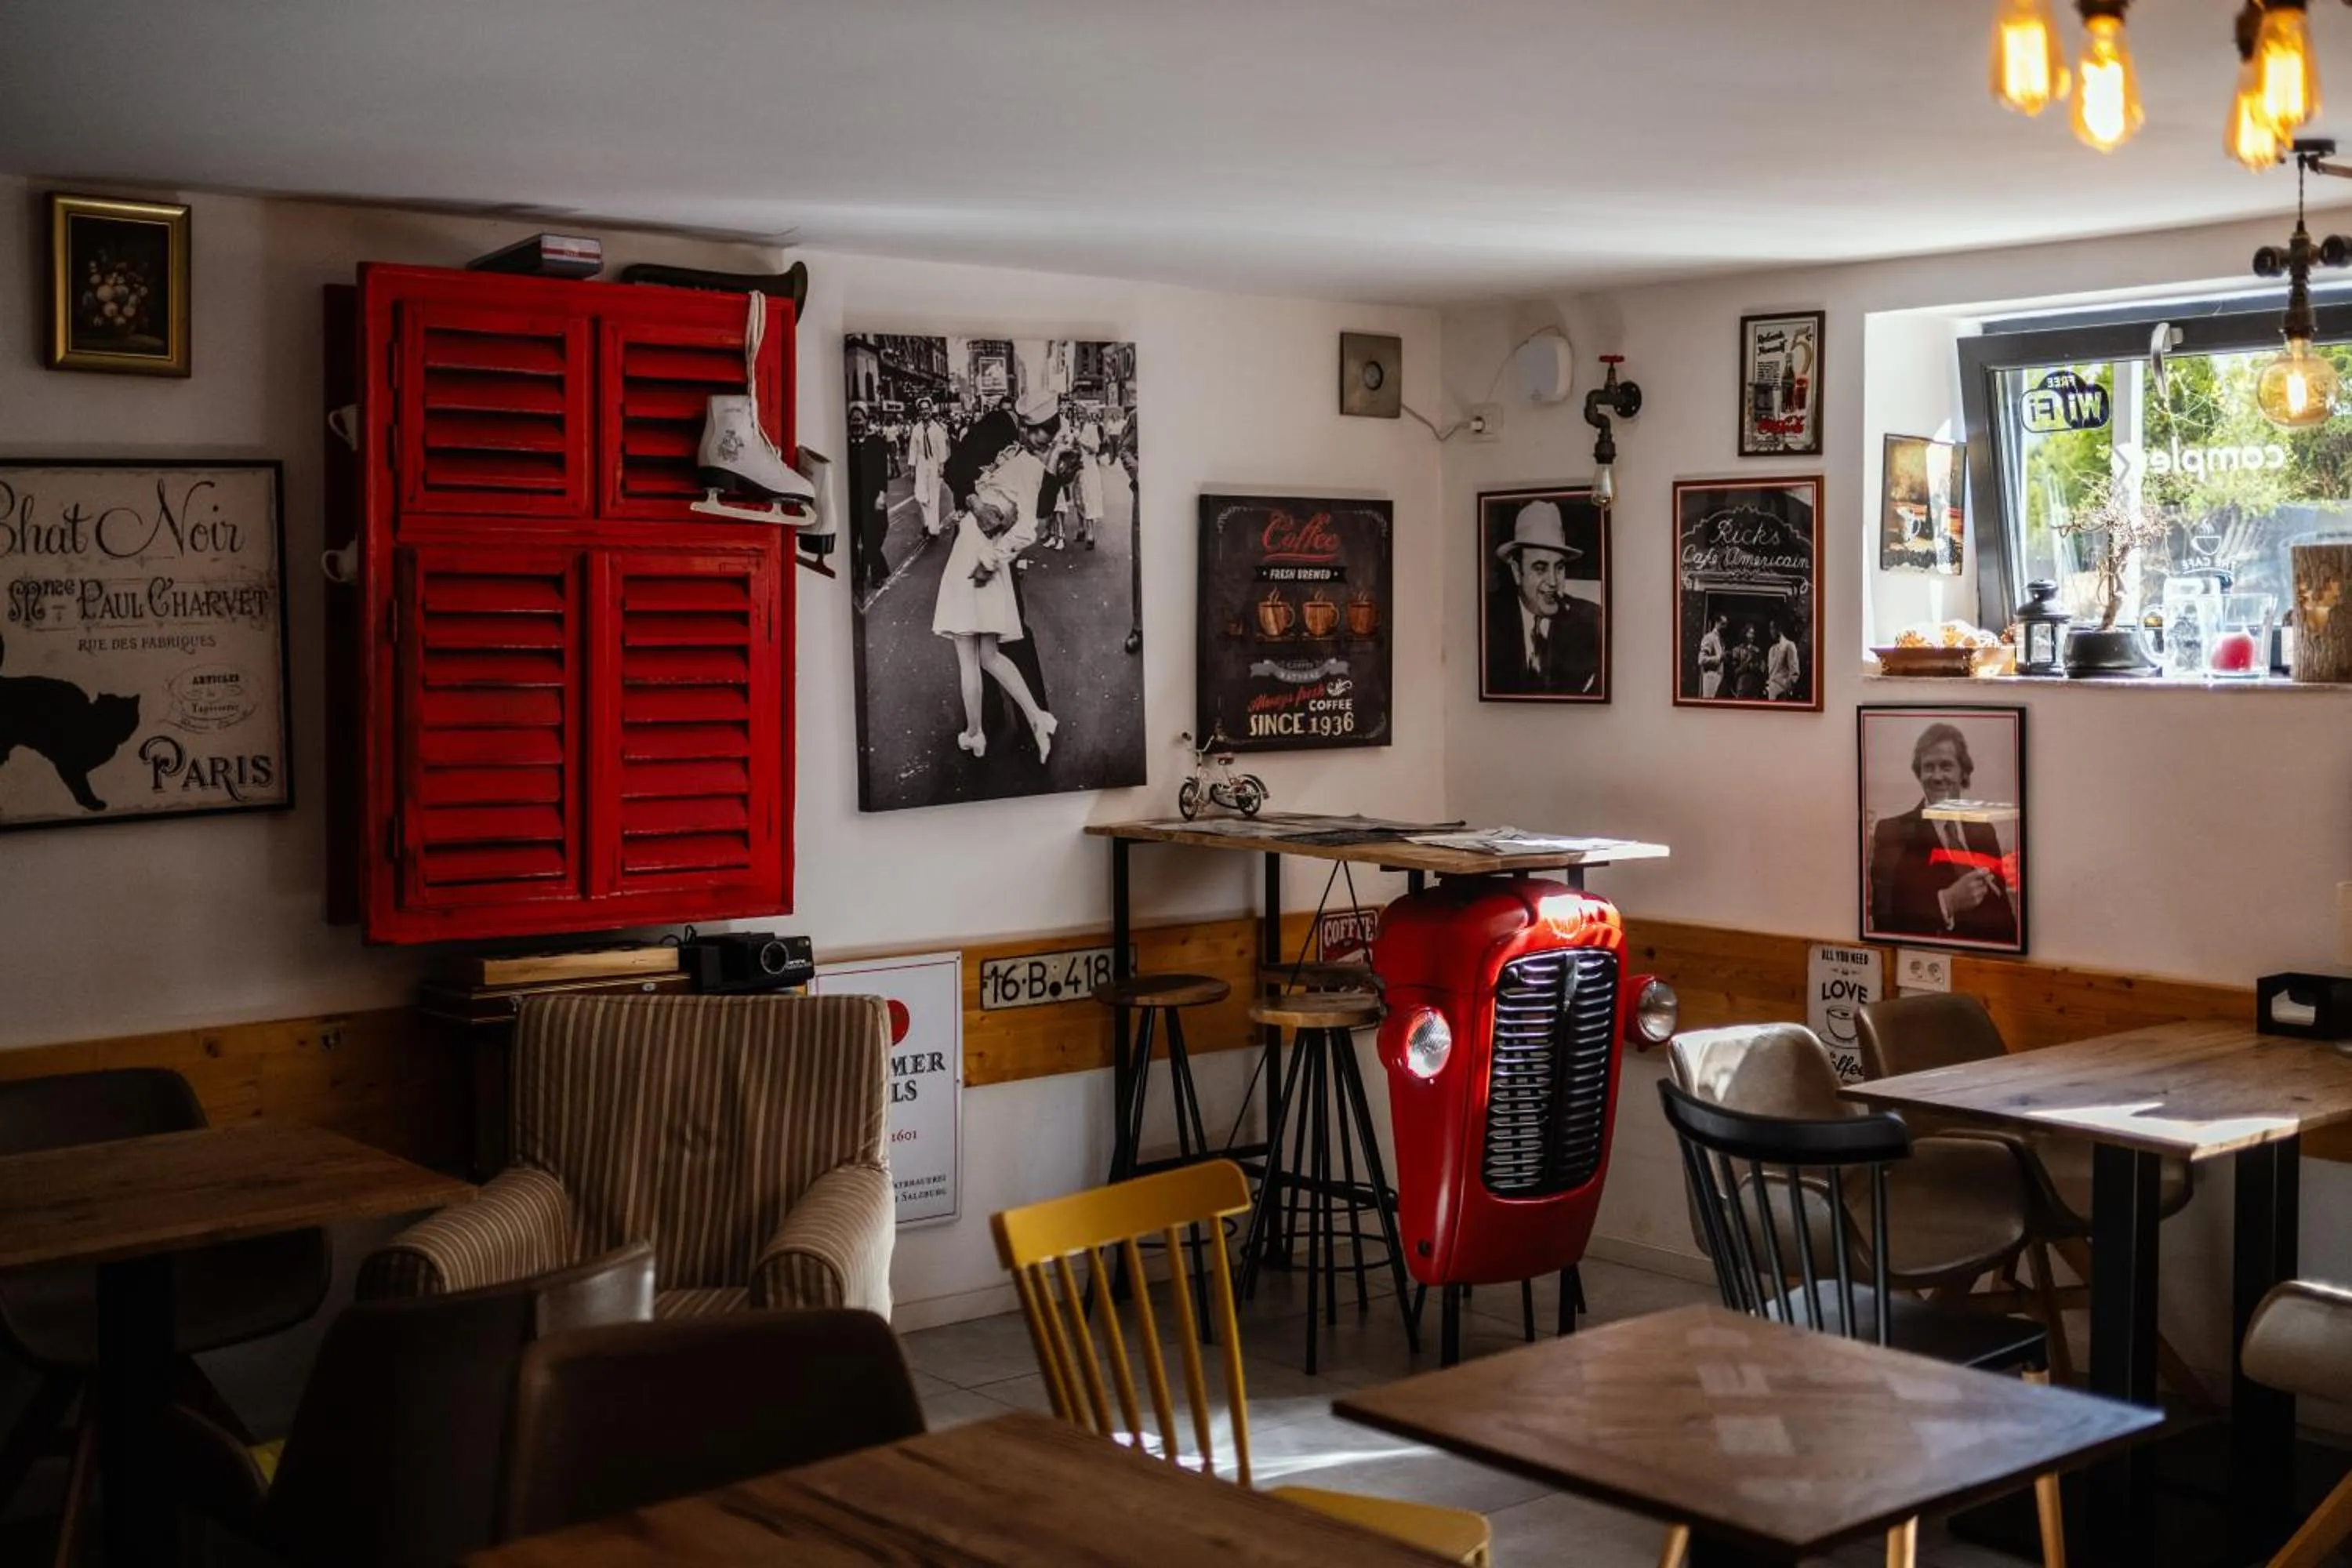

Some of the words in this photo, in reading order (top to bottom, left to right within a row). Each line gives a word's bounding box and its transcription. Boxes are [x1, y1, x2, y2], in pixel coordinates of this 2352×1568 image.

[95, 478, 245, 557] Noir
[1709, 517, 1781, 546] Rick's
[1269, 568, 1296, 580] FRESH
[1298, 568, 1332, 580] BREWED
[78, 579, 145, 621] PAUL
[148, 576, 269, 618] CHARVET
[77, 638, 107, 654] RUE
[112, 637, 138, 650] DES
[141, 635, 216, 655] FABRIQUES
[1308, 699, 1353, 712] COFFEE
[1249, 713, 1305, 737] SINCE
[1308, 712, 1355, 737] 1936
[139, 735, 273, 802] PARIS
[1821, 949, 1835, 961] ALL
[1835, 949, 1849, 963] YOU
[1850, 951, 1869, 965] NEED
[1821, 980, 1868, 1004] LOVE
[891, 1051, 946, 1077] MER
[891, 1080, 917, 1102] LS
[891, 1130, 917, 1142] 1601
[902, 1188, 947, 1202] SALZBURG
